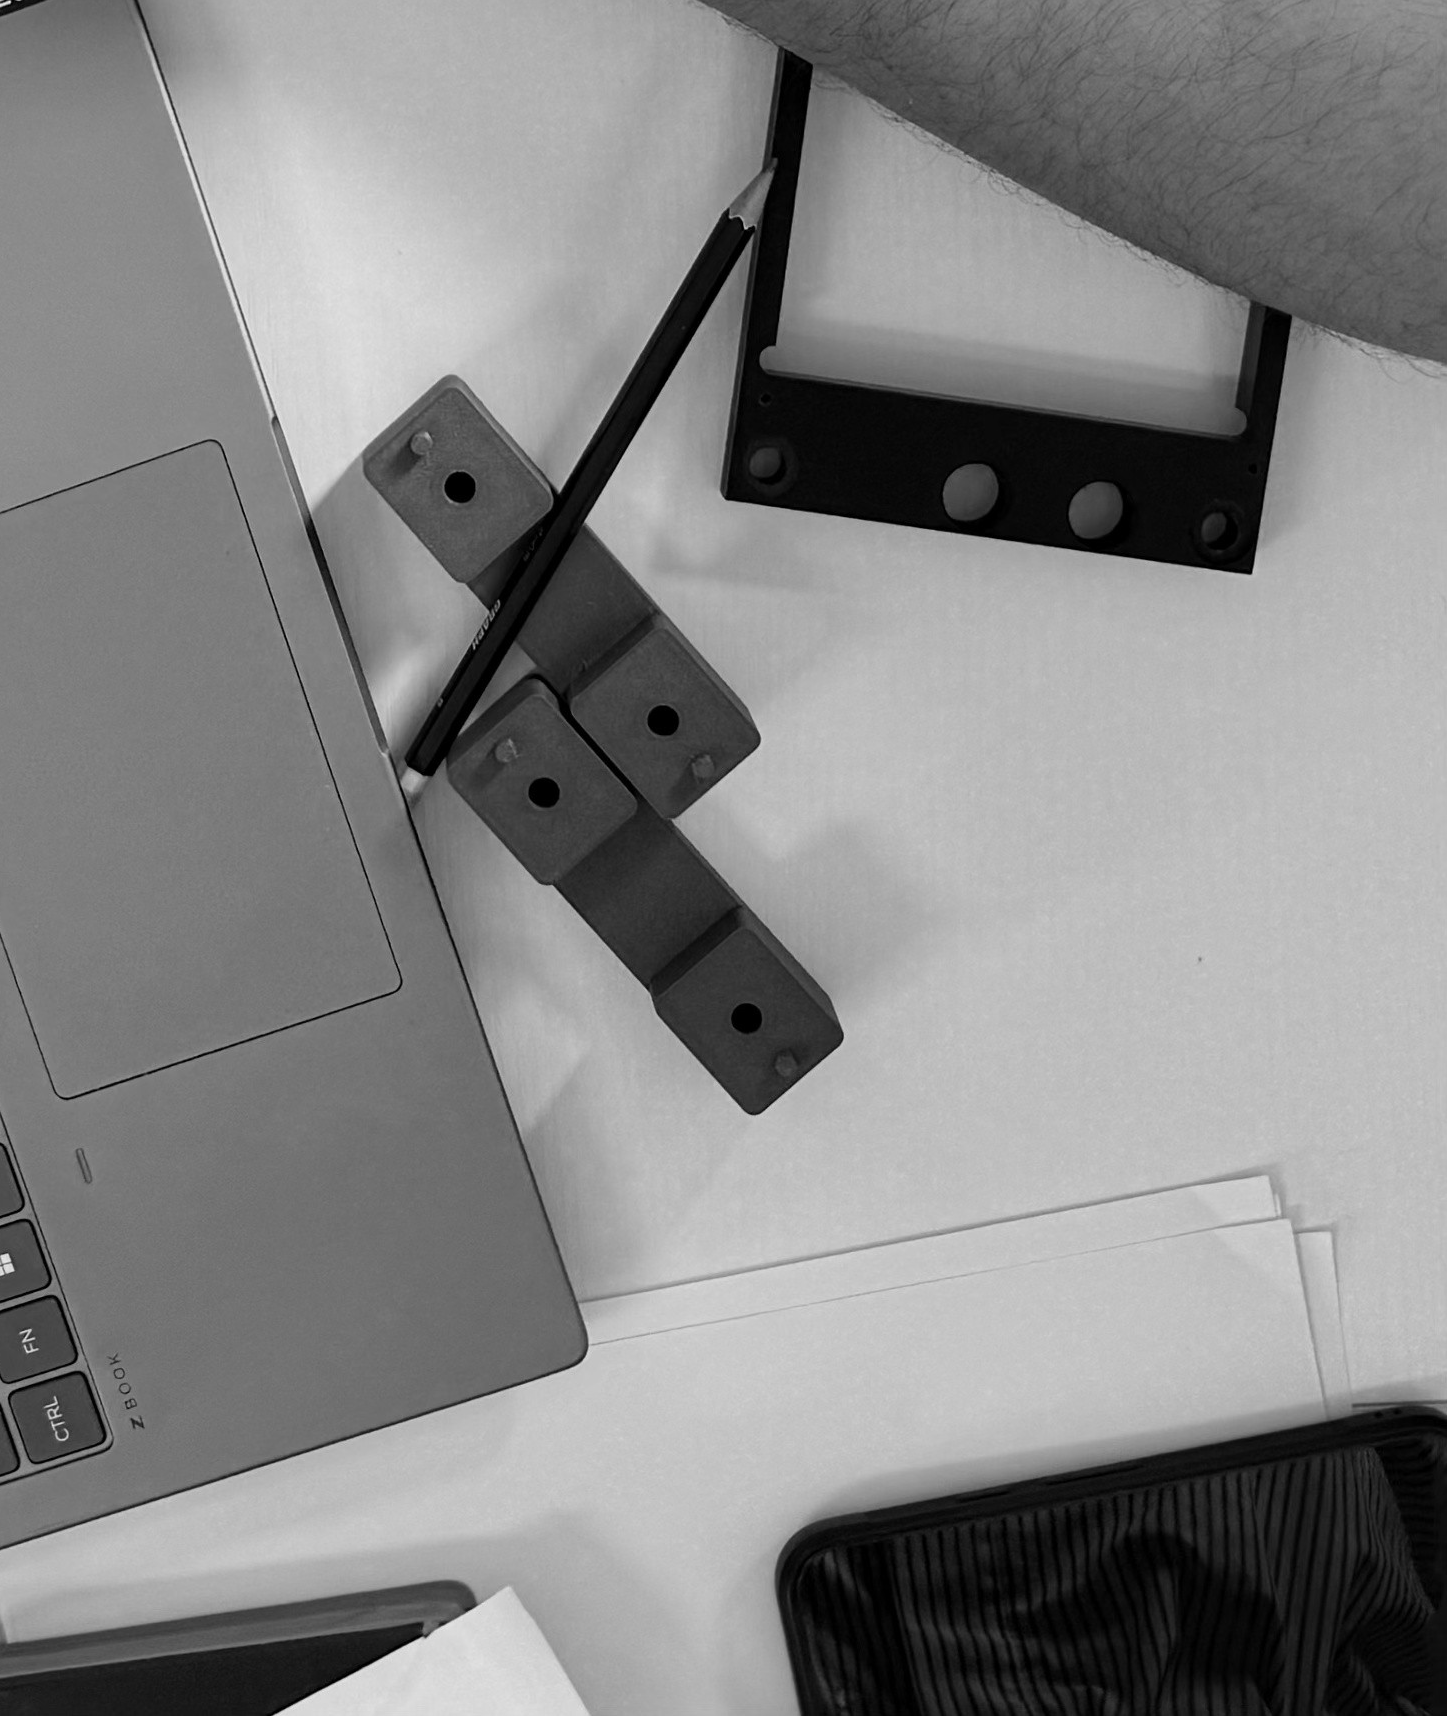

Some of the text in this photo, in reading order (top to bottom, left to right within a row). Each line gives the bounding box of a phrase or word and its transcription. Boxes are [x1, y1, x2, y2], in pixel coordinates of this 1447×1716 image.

[18, 1328, 39, 1354] FN
[108, 1353, 145, 1430] Z BOOK
[43, 1395, 70, 1442] CTRL
